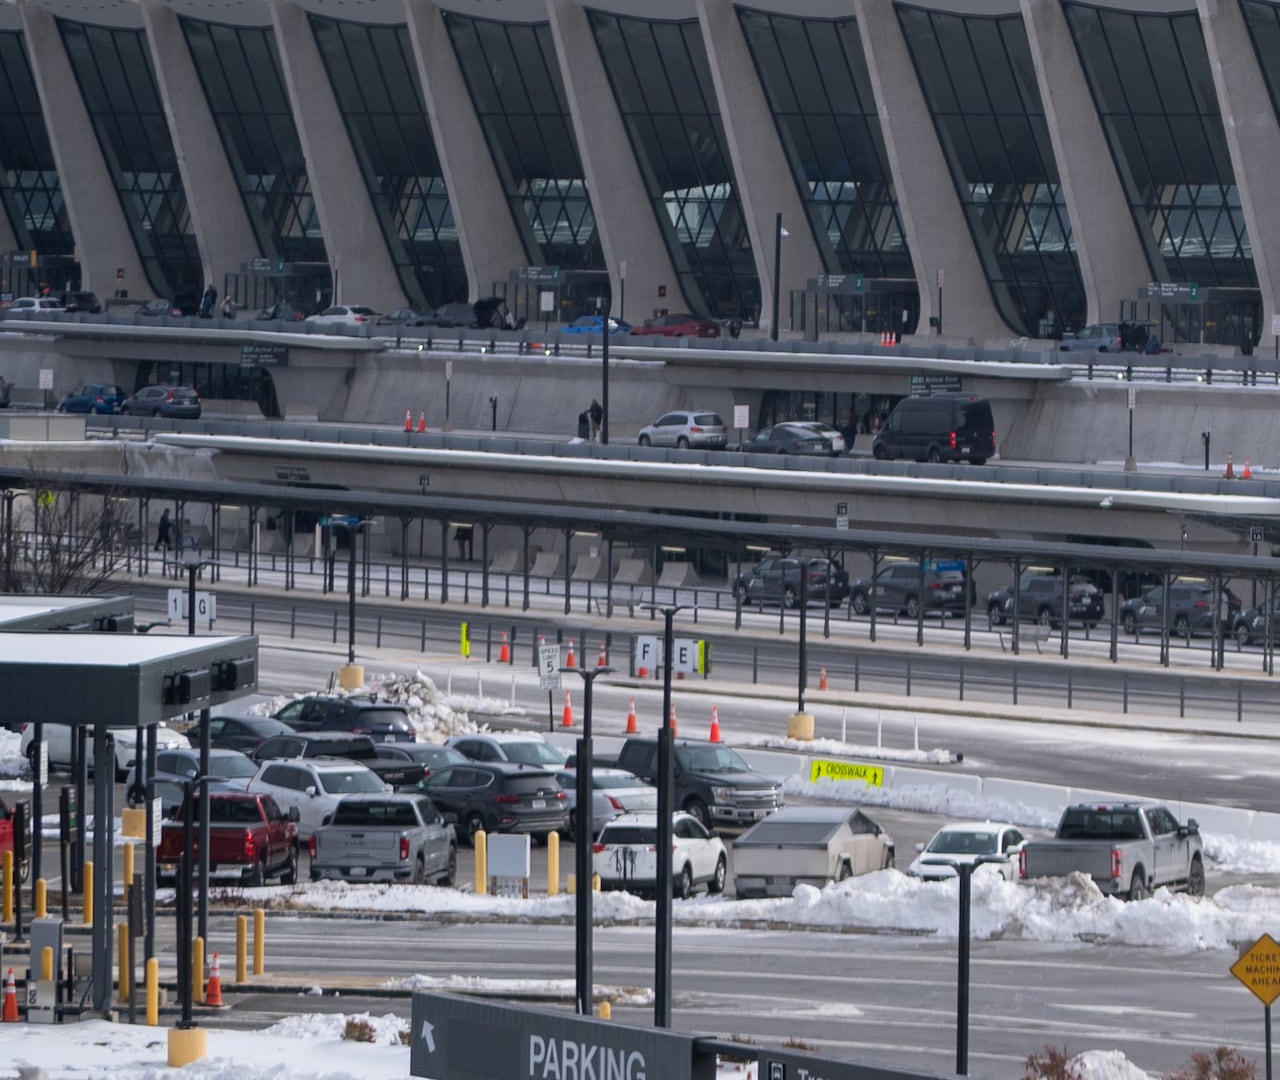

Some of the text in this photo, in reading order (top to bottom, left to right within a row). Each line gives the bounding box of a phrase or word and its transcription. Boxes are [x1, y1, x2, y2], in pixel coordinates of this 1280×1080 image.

[925, 375, 959, 383] Arrival Door
[172, 596, 178, 613] 1
[199, 598, 206, 615] G
[642, 643, 650, 660] F
[679, 646, 688, 664] E
[547, 660, 554, 673] 5
[825, 763, 868, 778] CROSSWALK
[529, 1034, 646, 1080] PARKING
